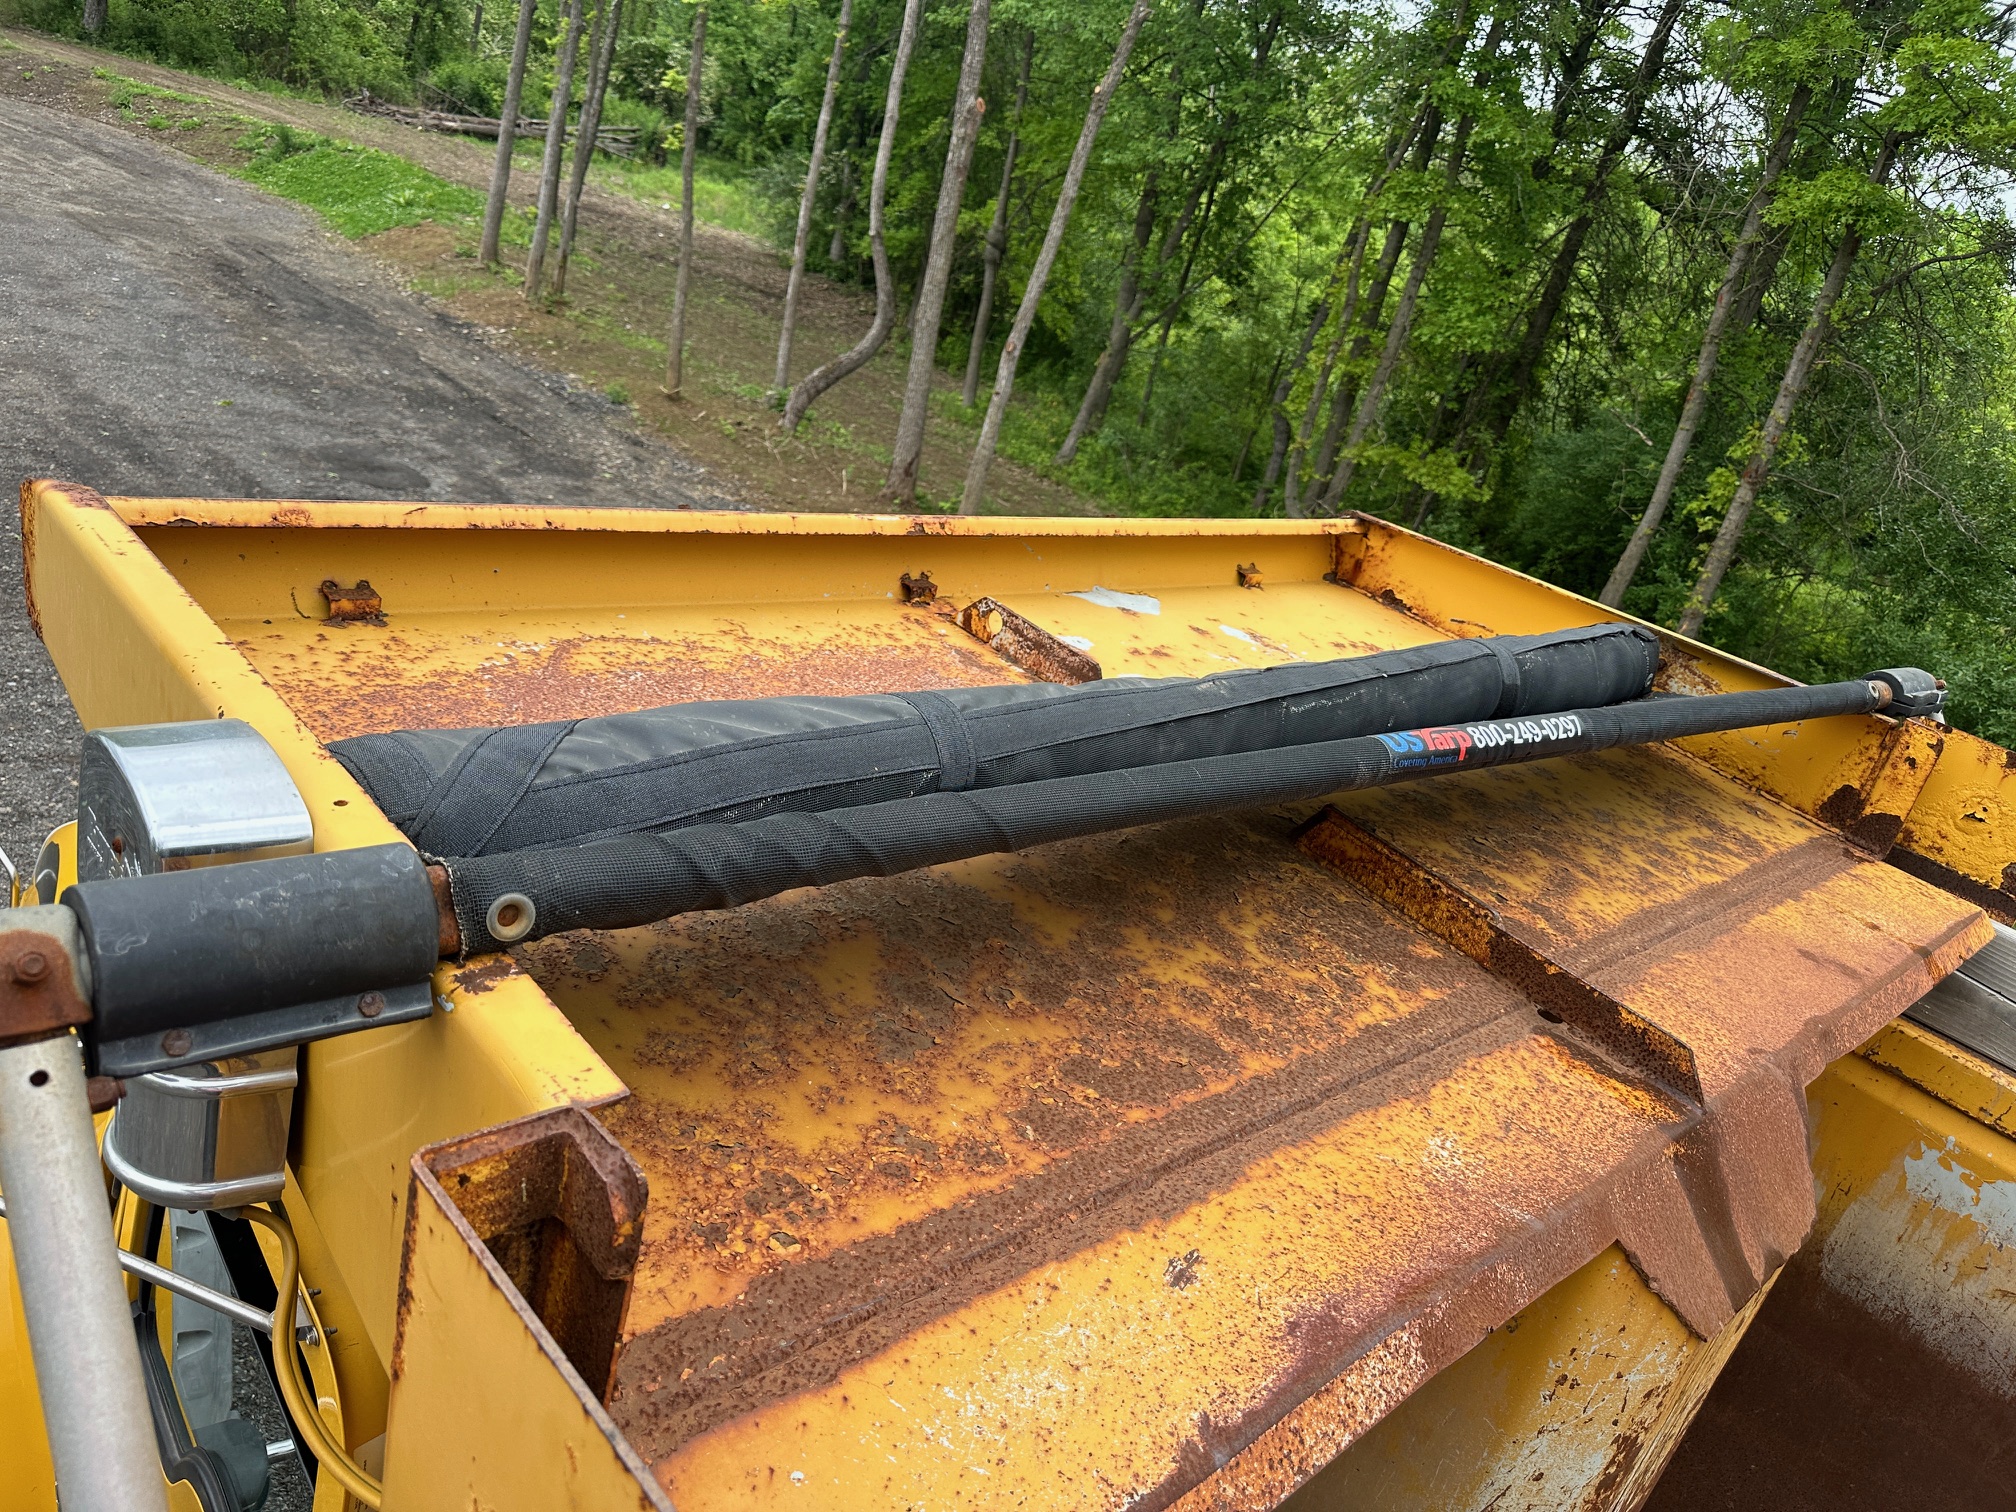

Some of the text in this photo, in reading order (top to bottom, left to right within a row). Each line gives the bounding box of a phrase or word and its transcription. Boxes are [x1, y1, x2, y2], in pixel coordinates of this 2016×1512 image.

[1466, 715, 1582, 748] 800-249-0297
[1393, 754, 1458, 768] Covering America
